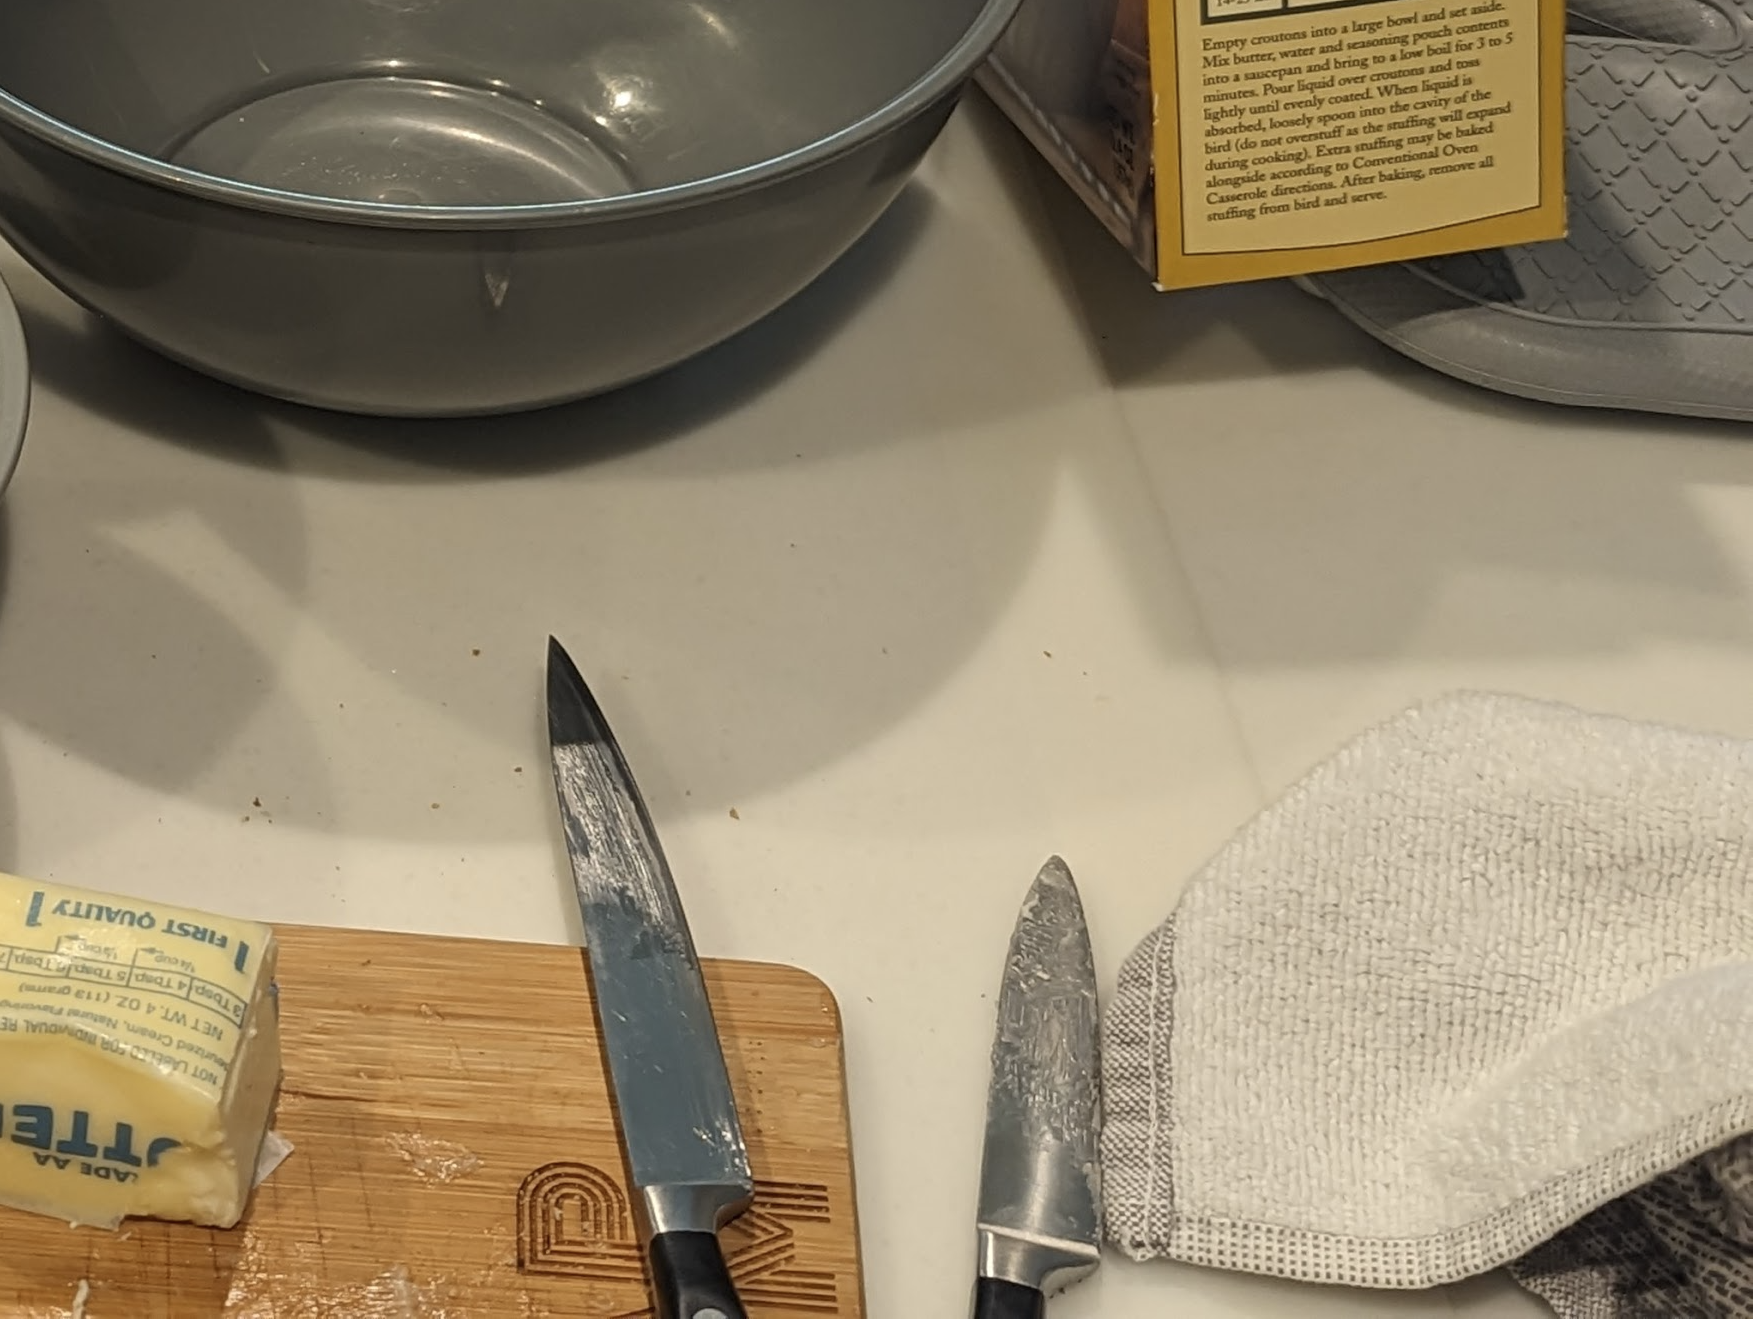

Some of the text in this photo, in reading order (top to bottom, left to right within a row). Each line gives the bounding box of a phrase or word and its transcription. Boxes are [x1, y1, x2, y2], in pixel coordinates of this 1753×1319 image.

[1205, 155, 1494, 205] Casserole directions. After baking, remove all
[1206, 191, 1387, 221] stuffing from bird and serve.
[52, 898, 157, 930] QUALITY
[161, 918, 229, 949] FIRST
[116, 969, 127, 981] 5
[177, 979, 187, 991] 4
[18, 981, 72, 996] grams)
[75, 988, 112, 1004] (113
[66, 1006, 119, 1029] Natural
[145, 1001, 157, 1015] 4
[159, 1004, 188, 1027] WT.
[232, 1003, 242, 1018] 3
[197, 1018, 224, 1042] NET
[101, 1033, 127, 1056] FOR
[191, 1068, 218, 1086] NOT
[33, 1150, 139, 1183] ADE AA
